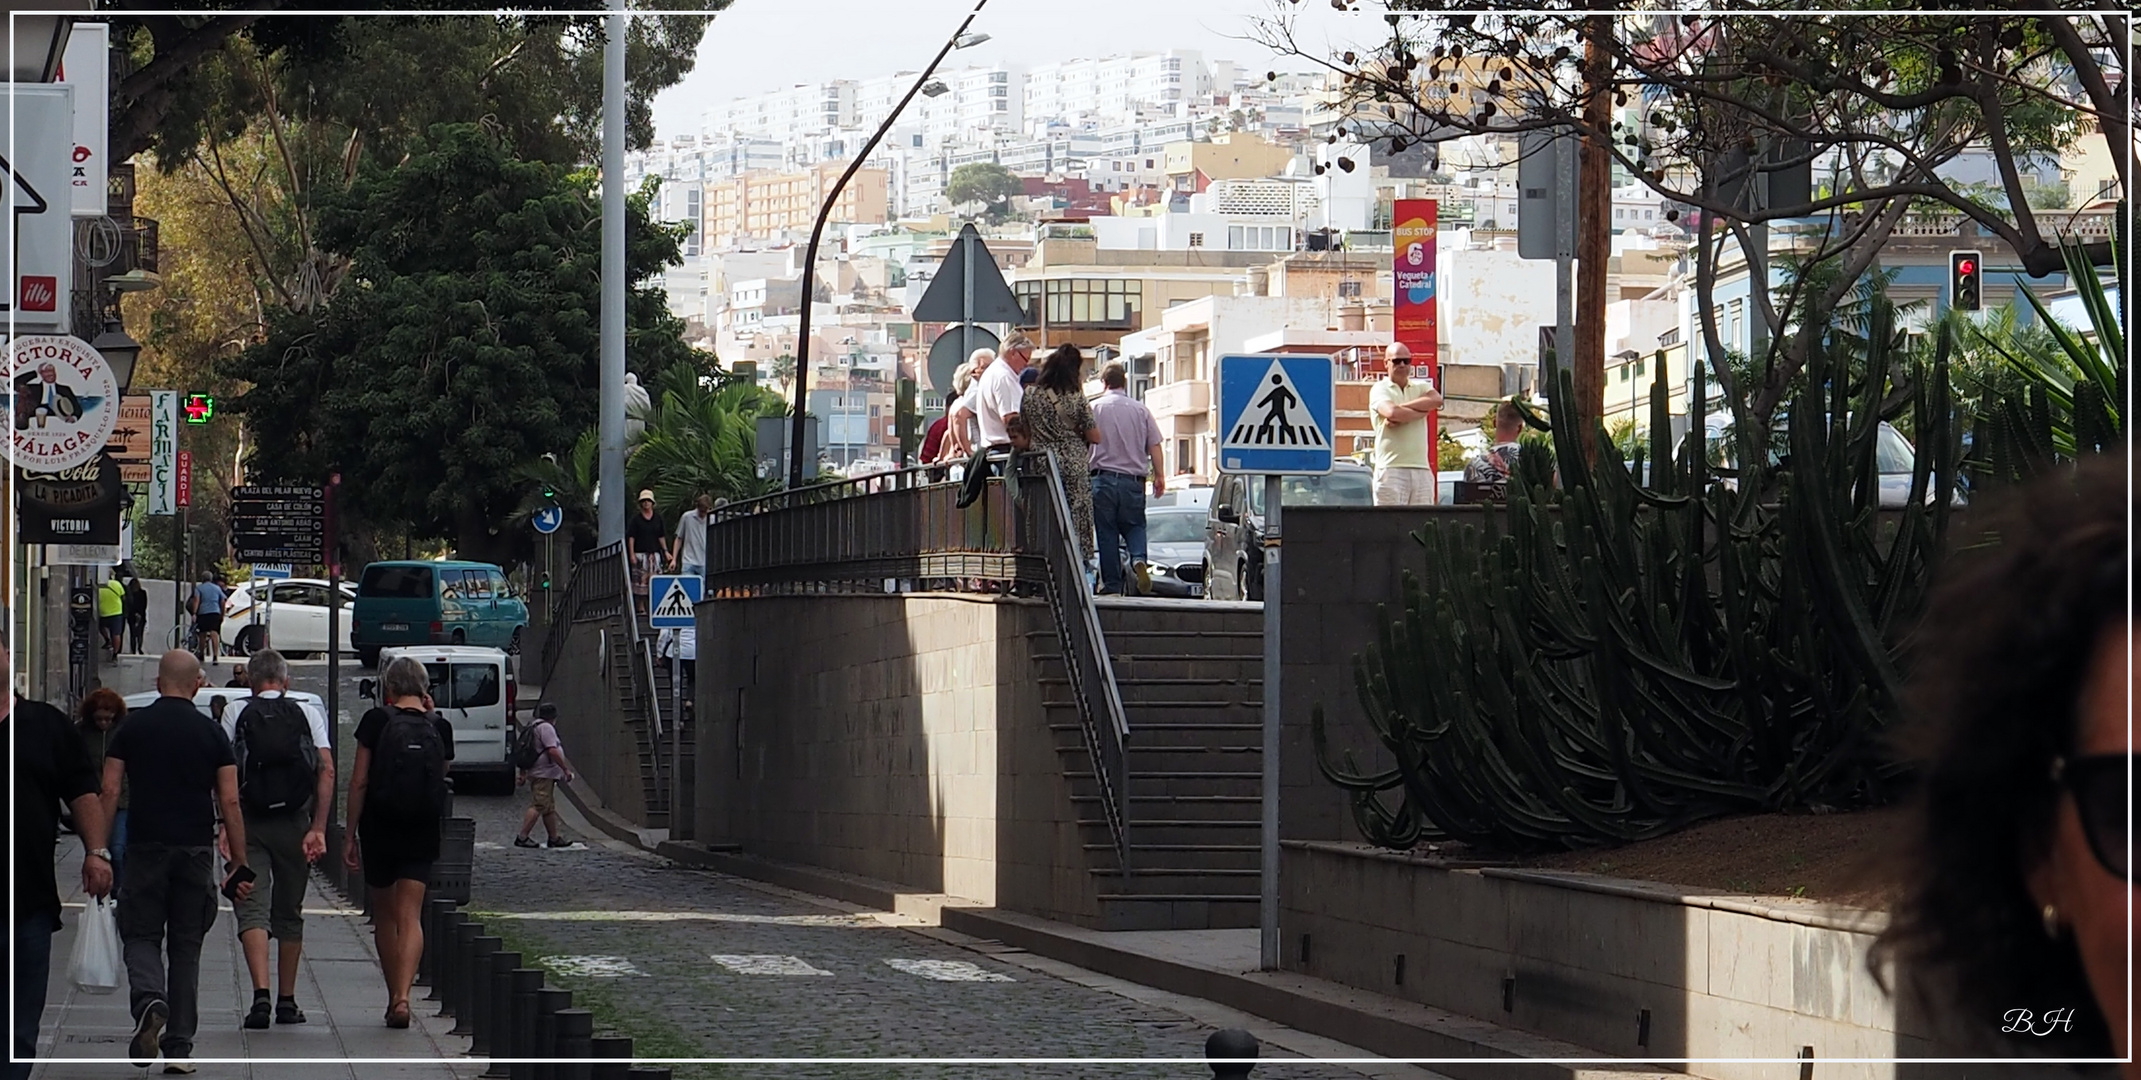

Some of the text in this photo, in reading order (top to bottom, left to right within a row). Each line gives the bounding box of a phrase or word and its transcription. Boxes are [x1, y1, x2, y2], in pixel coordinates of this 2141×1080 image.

[1396, 227, 1435, 237] BUS STOP
[1407, 242, 1424, 266] 6
[1397, 271, 1428, 283] Vegueta
[1399, 280, 1432, 290] Catedral
[24, 283, 52, 307] illy
[0, 345, 94, 381] VICTORIA
[6, 430, 90, 457] MÁLAGA
[154, 393, 172, 514] FARMACIA
[35, 483, 98, 504] LA PICADITA
[241, 487, 260, 495] PLAZA
[266, 503, 283, 511] CASA
[50, 519, 90, 532] VICTORIA
